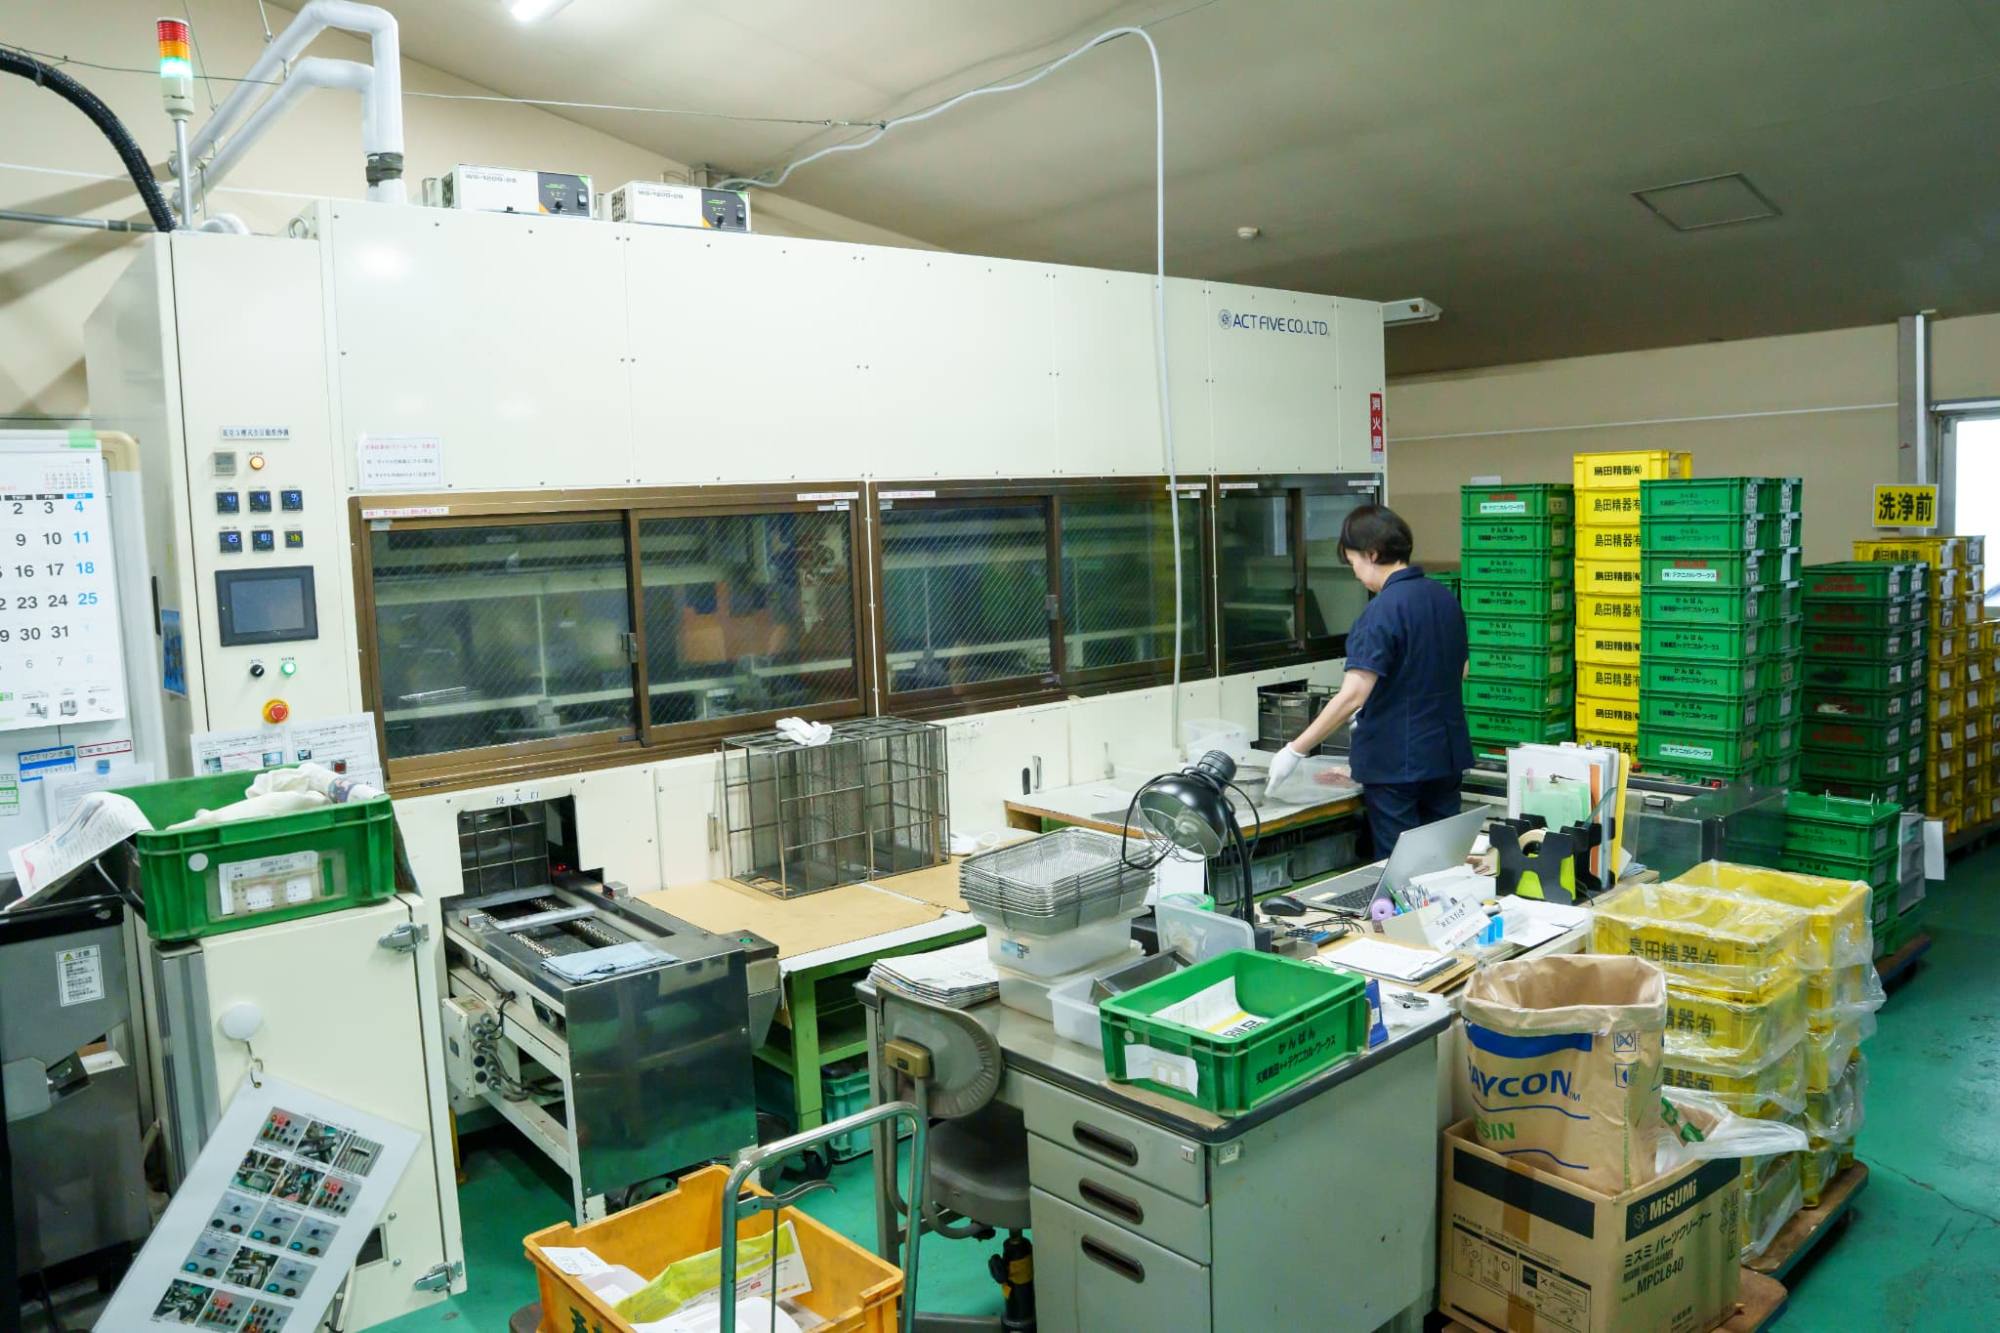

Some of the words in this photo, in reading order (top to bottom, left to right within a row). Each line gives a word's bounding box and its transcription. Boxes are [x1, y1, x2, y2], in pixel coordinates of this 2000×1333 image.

[1233, 313, 1258, 329] ACT
[1259, 315, 1286, 332] FIVE
[13, 503, 23, 515] 2
[44, 502, 54, 514] 3
[74, 501, 84, 512] 4
[1878, 492, 1933, 521] 洗浄前
[16, 534, 26, 546] 9
[42, 532, 62, 545] 10
[73, 531, 89, 544] 11
[15, 565, 34, 578] 16
[46, 563, 64, 576] 17
[76, 561, 94, 574] 18
[17, 596, 38, 609] 23
[47, 594, 68, 608] 24
[78, 592, 98, 605] 25
[0, 629, 10, 642] 9
[20, 627, 41, 641] 30
[51, 625, 69, 639] 31
[25, 659, 34, 669] 6
[56, 656, 64, 666] 7
[1469, 1056, 1572, 1097] AYCON
[1624, 1244, 1653, 1268] ミスミ
[1655, 1211, 1712, 1254] パーツクリーナー
[1636, 1255, 1685, 1297] MPCL840
